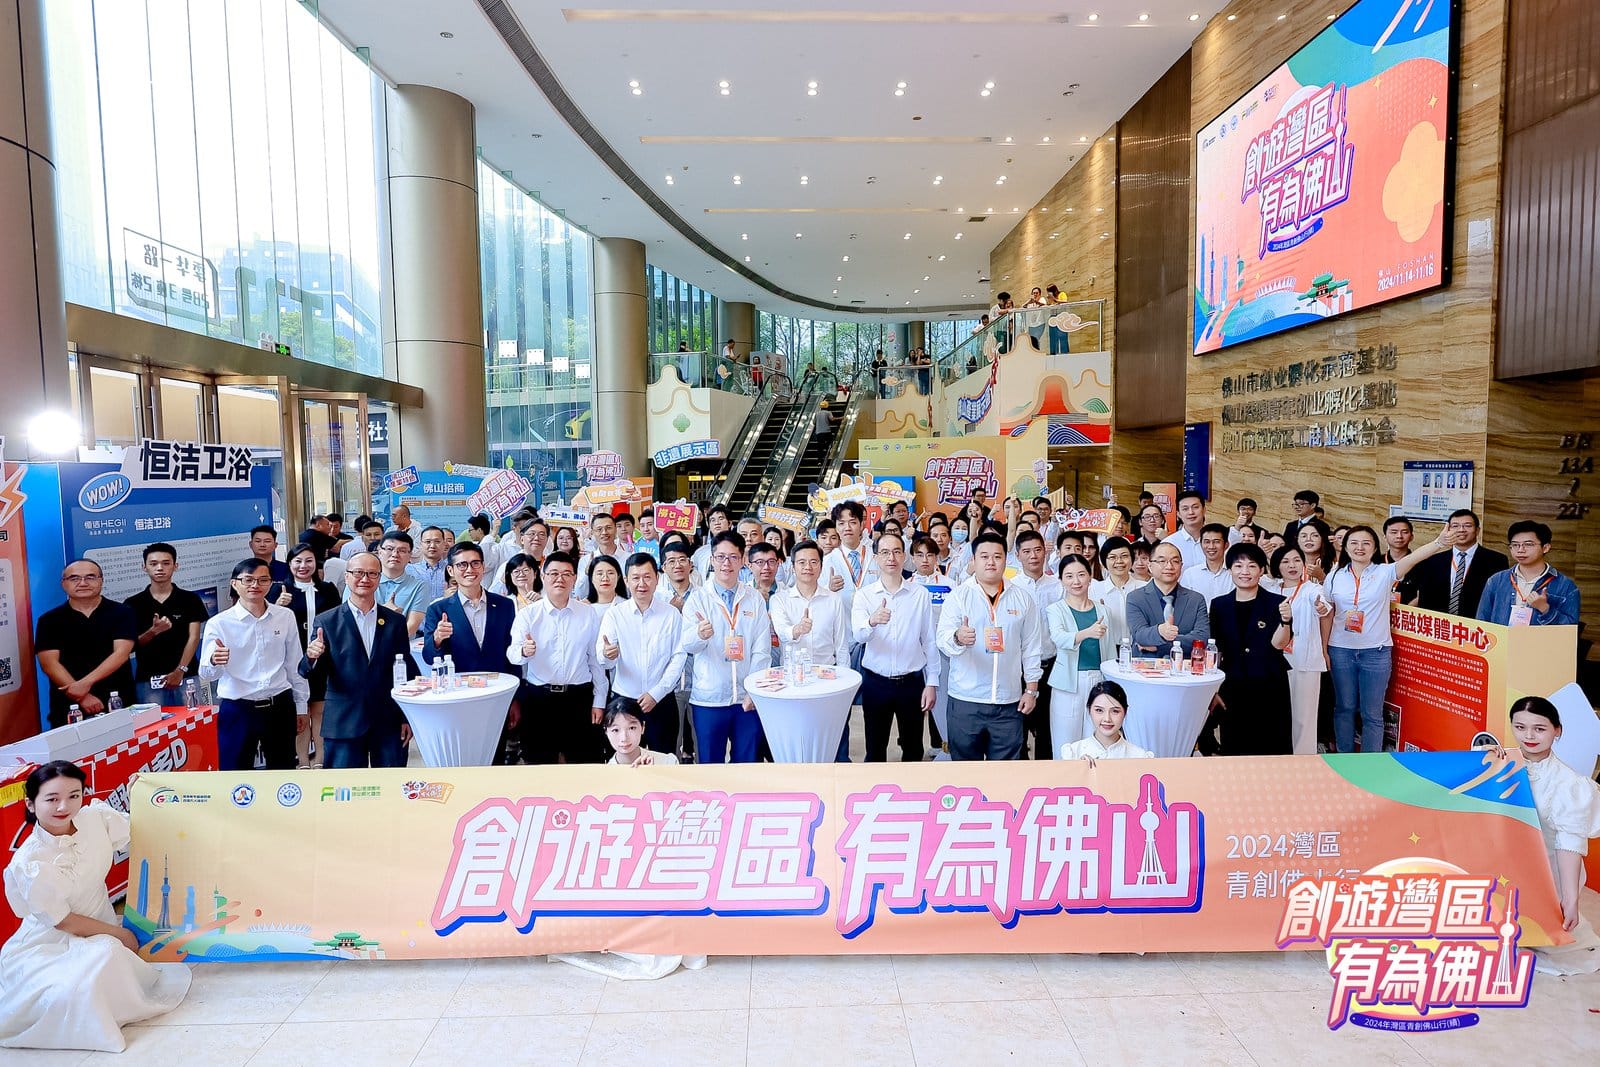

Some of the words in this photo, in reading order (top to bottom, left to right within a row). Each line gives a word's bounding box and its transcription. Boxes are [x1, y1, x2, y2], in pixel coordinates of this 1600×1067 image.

[1243, 86, 1335, 202] 創遊灣區
[1260, 125, 1353, 258] 有為佛山
[139, 440, 253, 482] 恒洁卫浴
[656, 441, 719, 466] 非遺展示區
[925, 458, 987, 479] 創遊灣區
[87, 477, 124, 507] WOW!
[423, 483, 465, 494] 佛山招商
[939, 472, 998, 504] 有為佛山
[134, 517, 172, 530] 恒洁卫浴
[437, 797, 819, 921] 創遊灣區
[843, 782, 1191, 926] 有為佛山
[1226, 832, 1341, 859] 2024灣區
